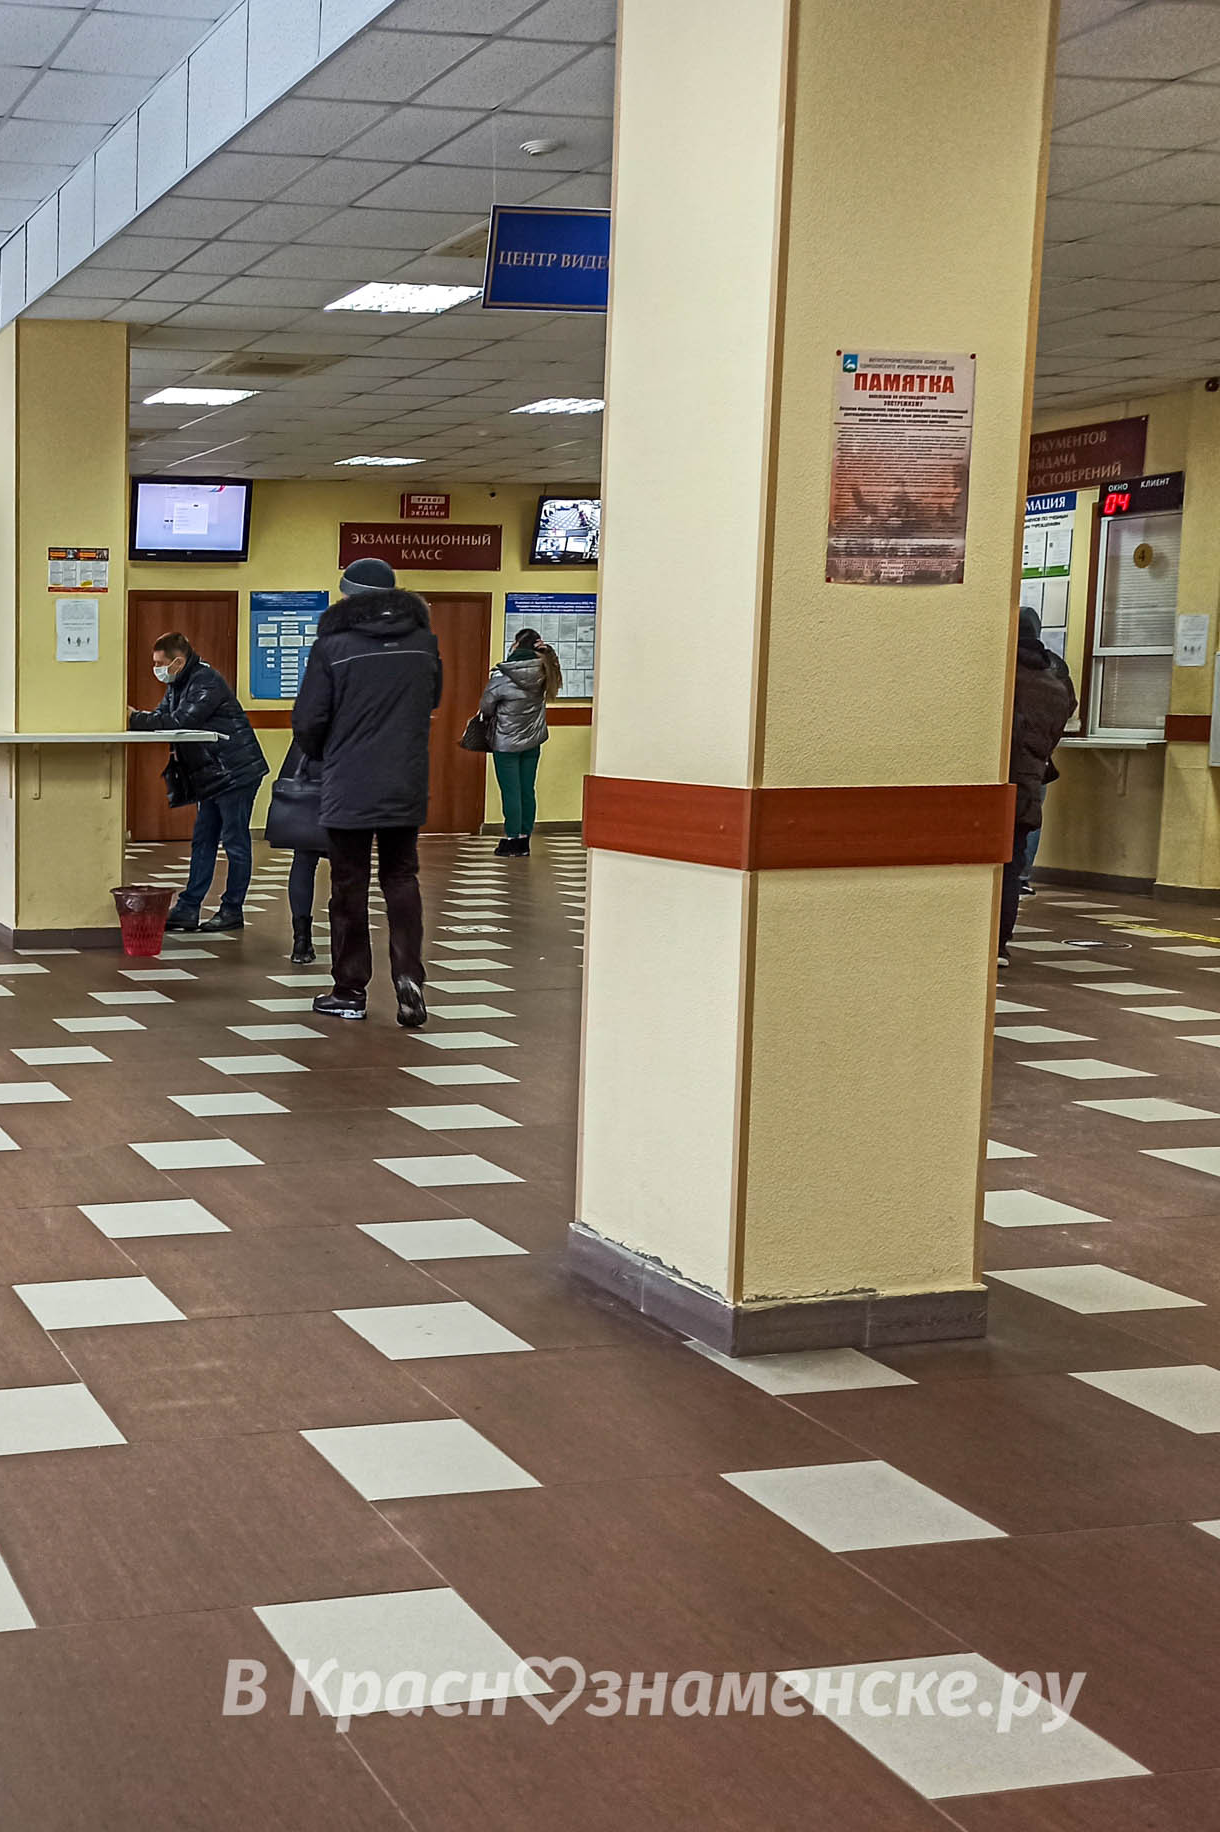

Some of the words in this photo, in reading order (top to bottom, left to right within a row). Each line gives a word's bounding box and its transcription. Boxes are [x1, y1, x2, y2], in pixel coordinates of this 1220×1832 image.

[499, 251, 557, 268] ЦЕНТР
[561, 253, 609, 271] ВИДЕ
[854, 372, 955, 394] ПАМЯТКА
[1031, 430, 1107, 454] ОКУМЕНТОВ
[1028, 461, 1121, 488] ОСТОВЕРЕНИЙ
[1108, 483, 1128, 492] ОКНО
[1140, 477, 1170, 489] КЛИЕНТ
[1025, 496, 1066, 512] МАЦИЯ
[1104, 493, 1131, 514] 04
[350, 532, 491, 546] ЭКЗАМЕНАЦИОННЫЙ
[401, 550, 443, 560] КЛАСС
